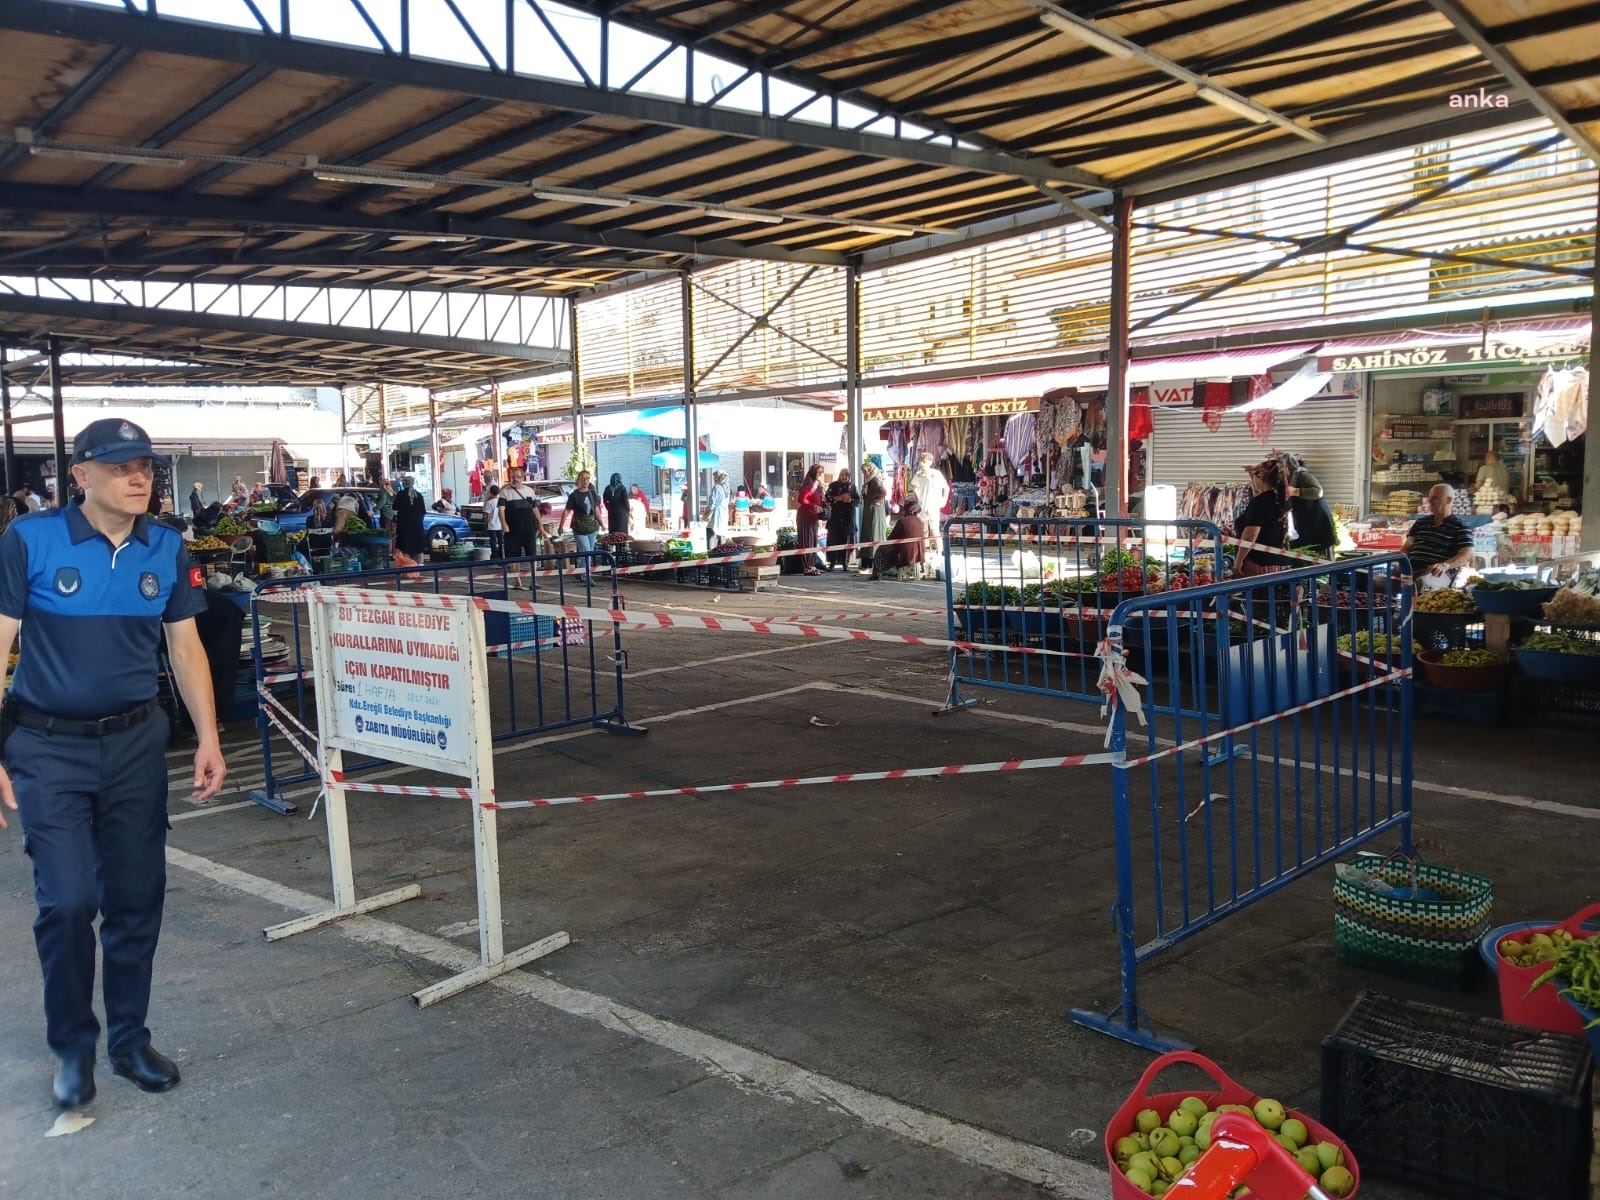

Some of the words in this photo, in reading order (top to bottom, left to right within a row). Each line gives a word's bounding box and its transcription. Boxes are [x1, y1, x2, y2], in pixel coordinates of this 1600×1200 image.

[1154, 387, 1195, 403] VAT
[886, 403, 959, 419] TUHAFİYE
[966, 403, 976, 414] &
[339, 606, 352, 621] BU
[355, 608, 396, 626] TEZGAH
[398, 611, 450, 631] BELEDİYE
[333, 632, 404, 655] KURALLARINA
[406, 641, 460, 662] UYMADIĞI
[345, 660, 368, 680] İÇİN
[370, 663, 450, 692] KAPATILMIŞTIR
[365, 683, 397, 701] HAFTA
[349, 698, 383, 716] Kdz.Ereğli
[384, 704, 413, 721] Belediye
[413, 709, 452, 729] Başkanlığı
[365, 720, 390, 736] ZABITA
[391, 723, 437, 745] MÜDÜRLÜĞÜ
